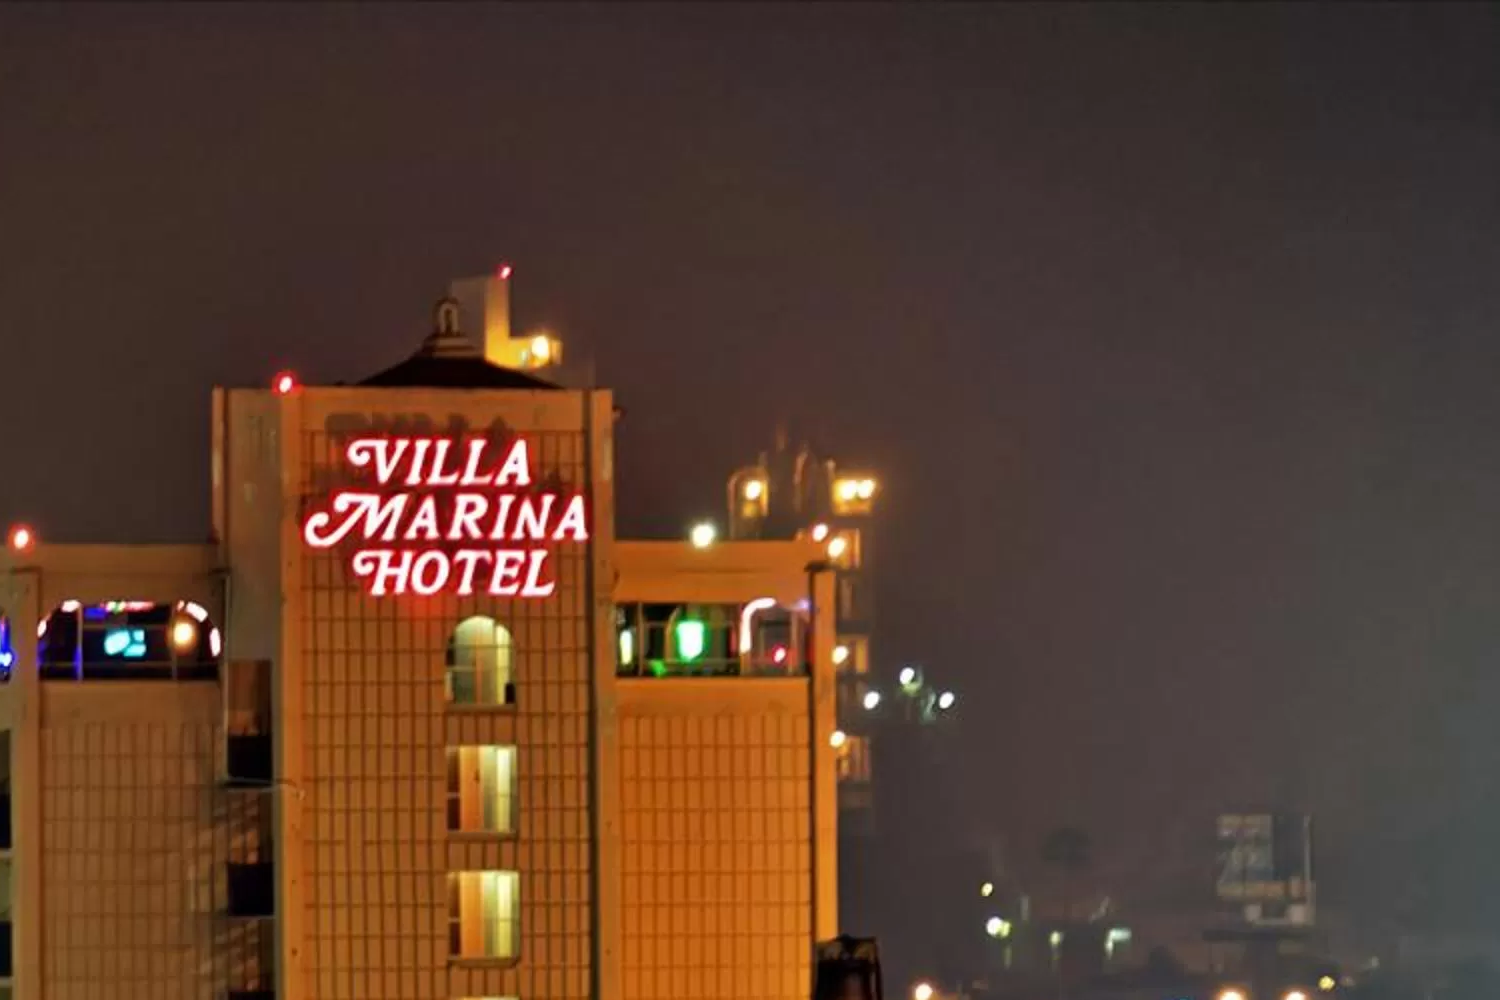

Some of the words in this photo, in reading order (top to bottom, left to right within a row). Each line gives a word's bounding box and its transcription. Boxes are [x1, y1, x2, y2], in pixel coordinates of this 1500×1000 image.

[347, 439, 531, 486] VILLA
[305, 493, 588, 547] MARINA
[353, 550, 555, 597] HOTEL
